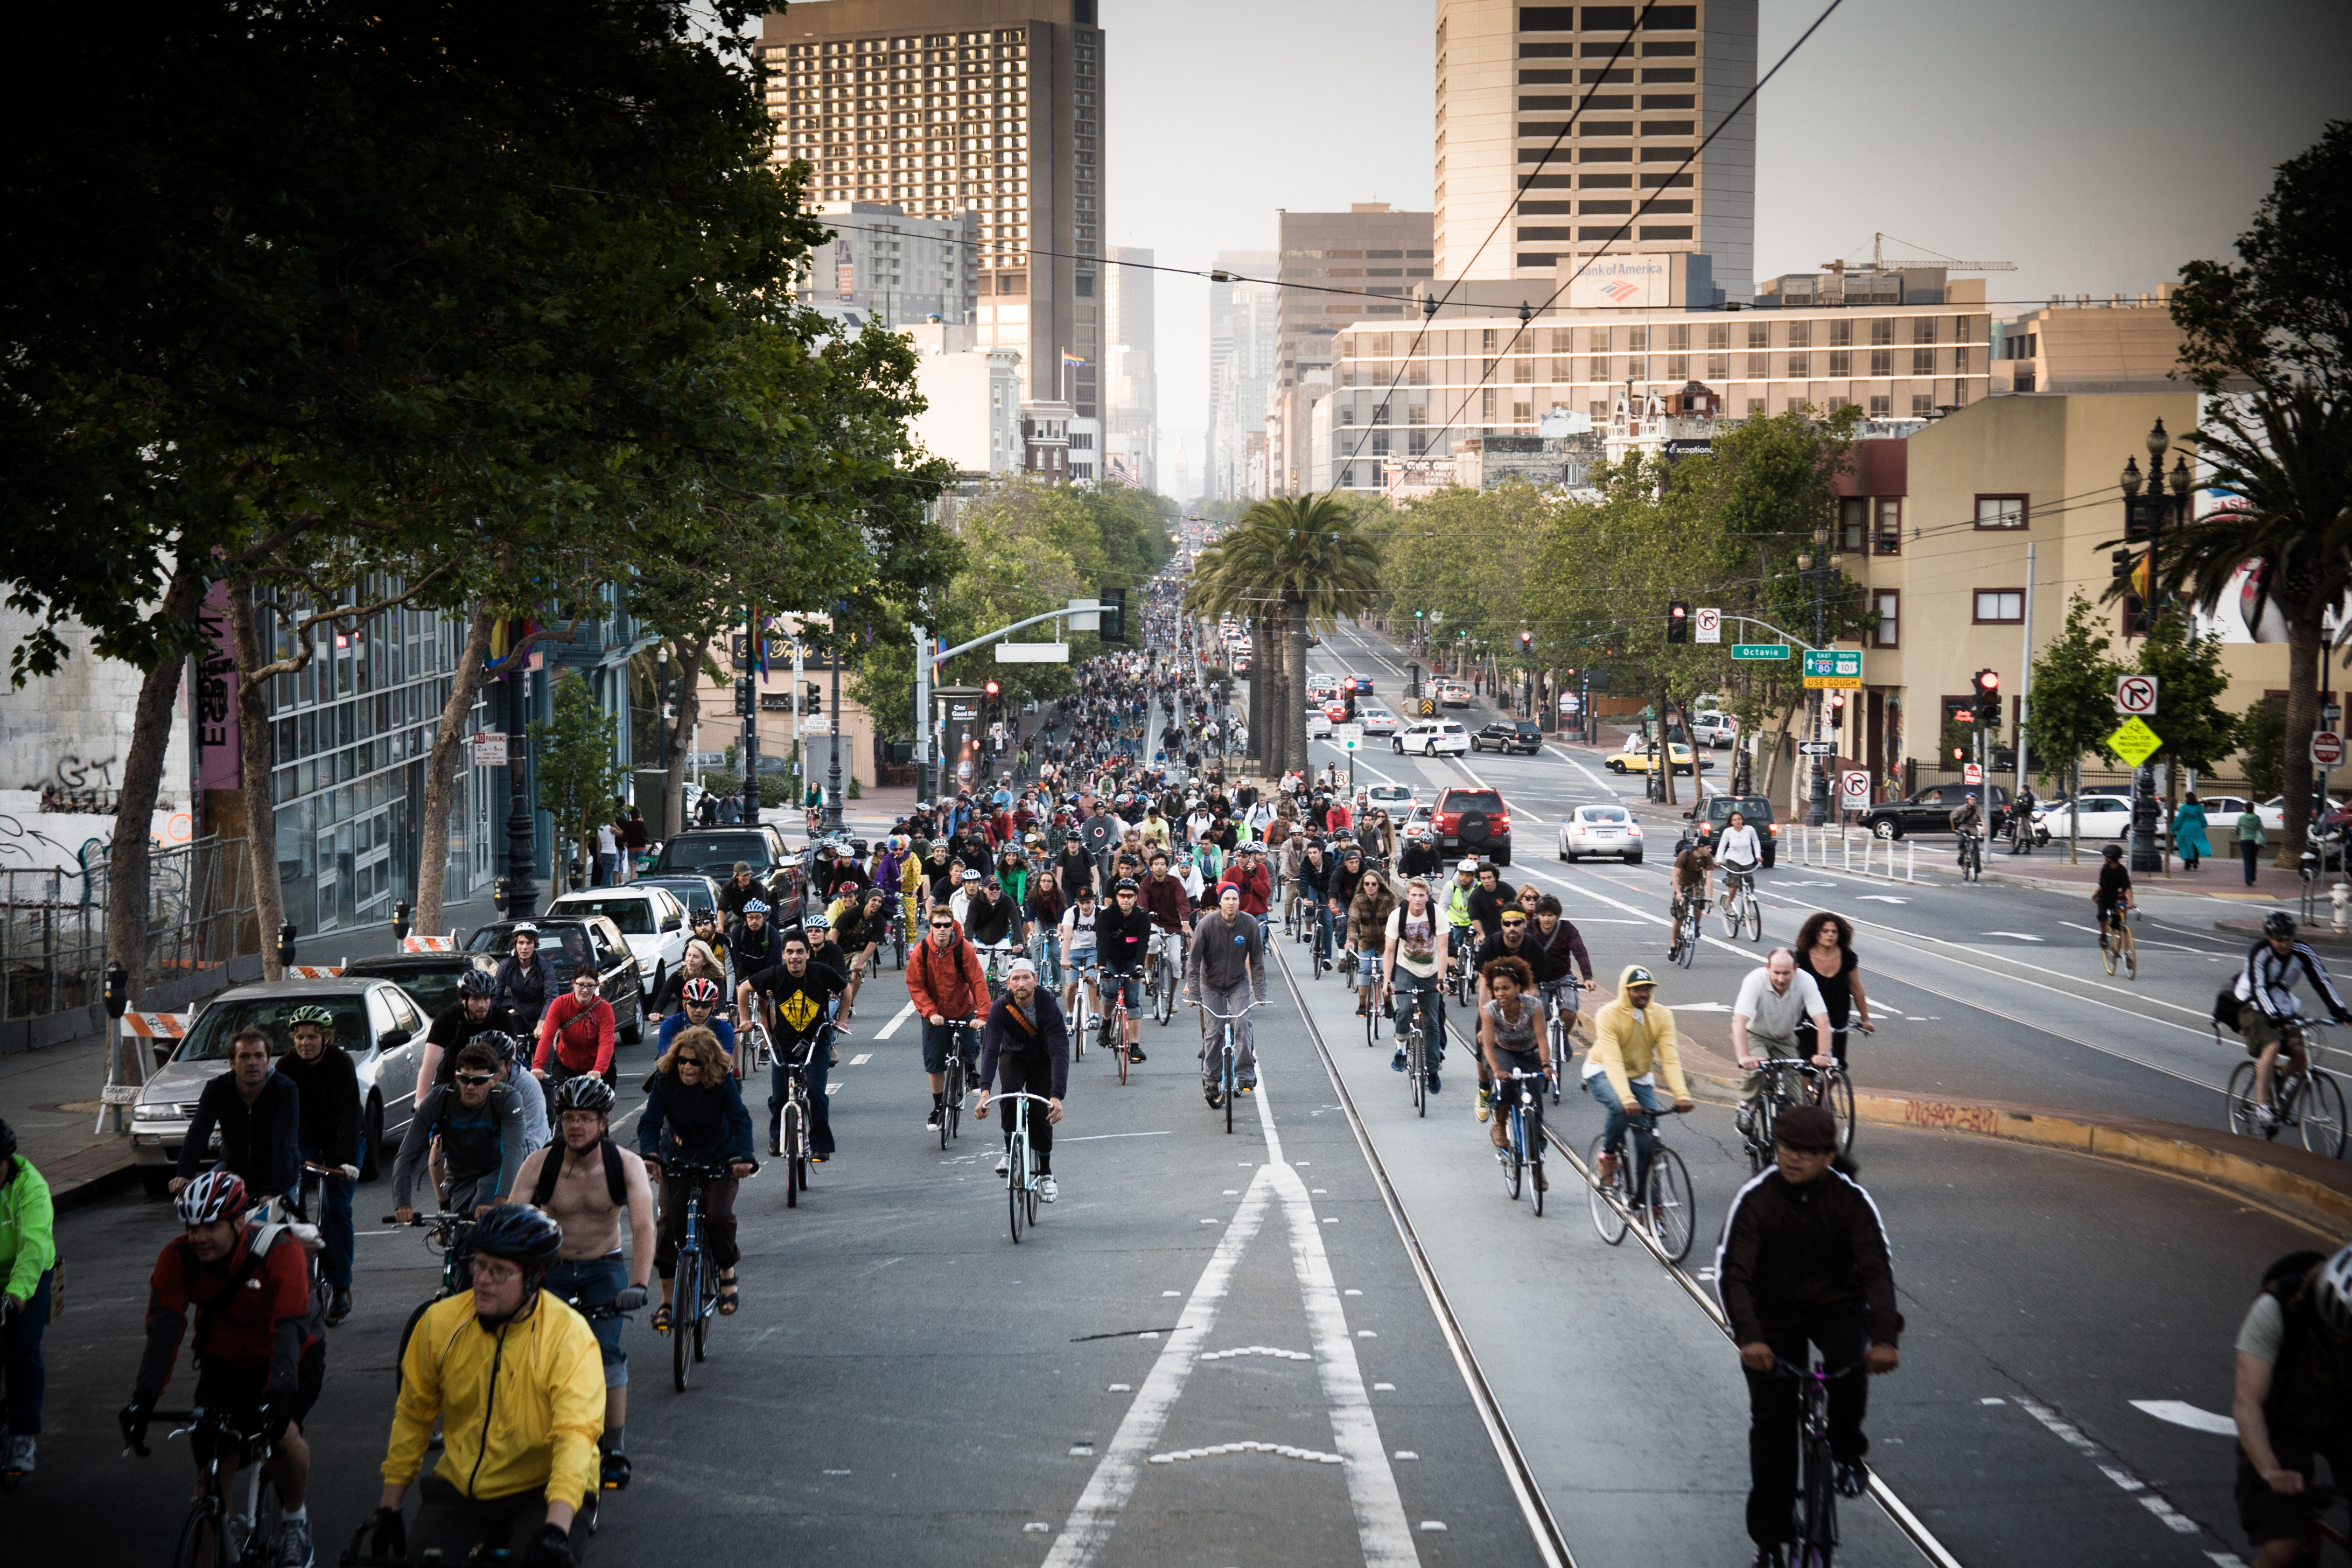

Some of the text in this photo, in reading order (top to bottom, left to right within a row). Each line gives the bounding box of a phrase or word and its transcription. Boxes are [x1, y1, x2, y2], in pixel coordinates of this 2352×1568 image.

[1578, 263, 1662, 275] Bank of America
[1743, 648, 1779, 656] Octavia
[475, 734, 484, 743] NO
